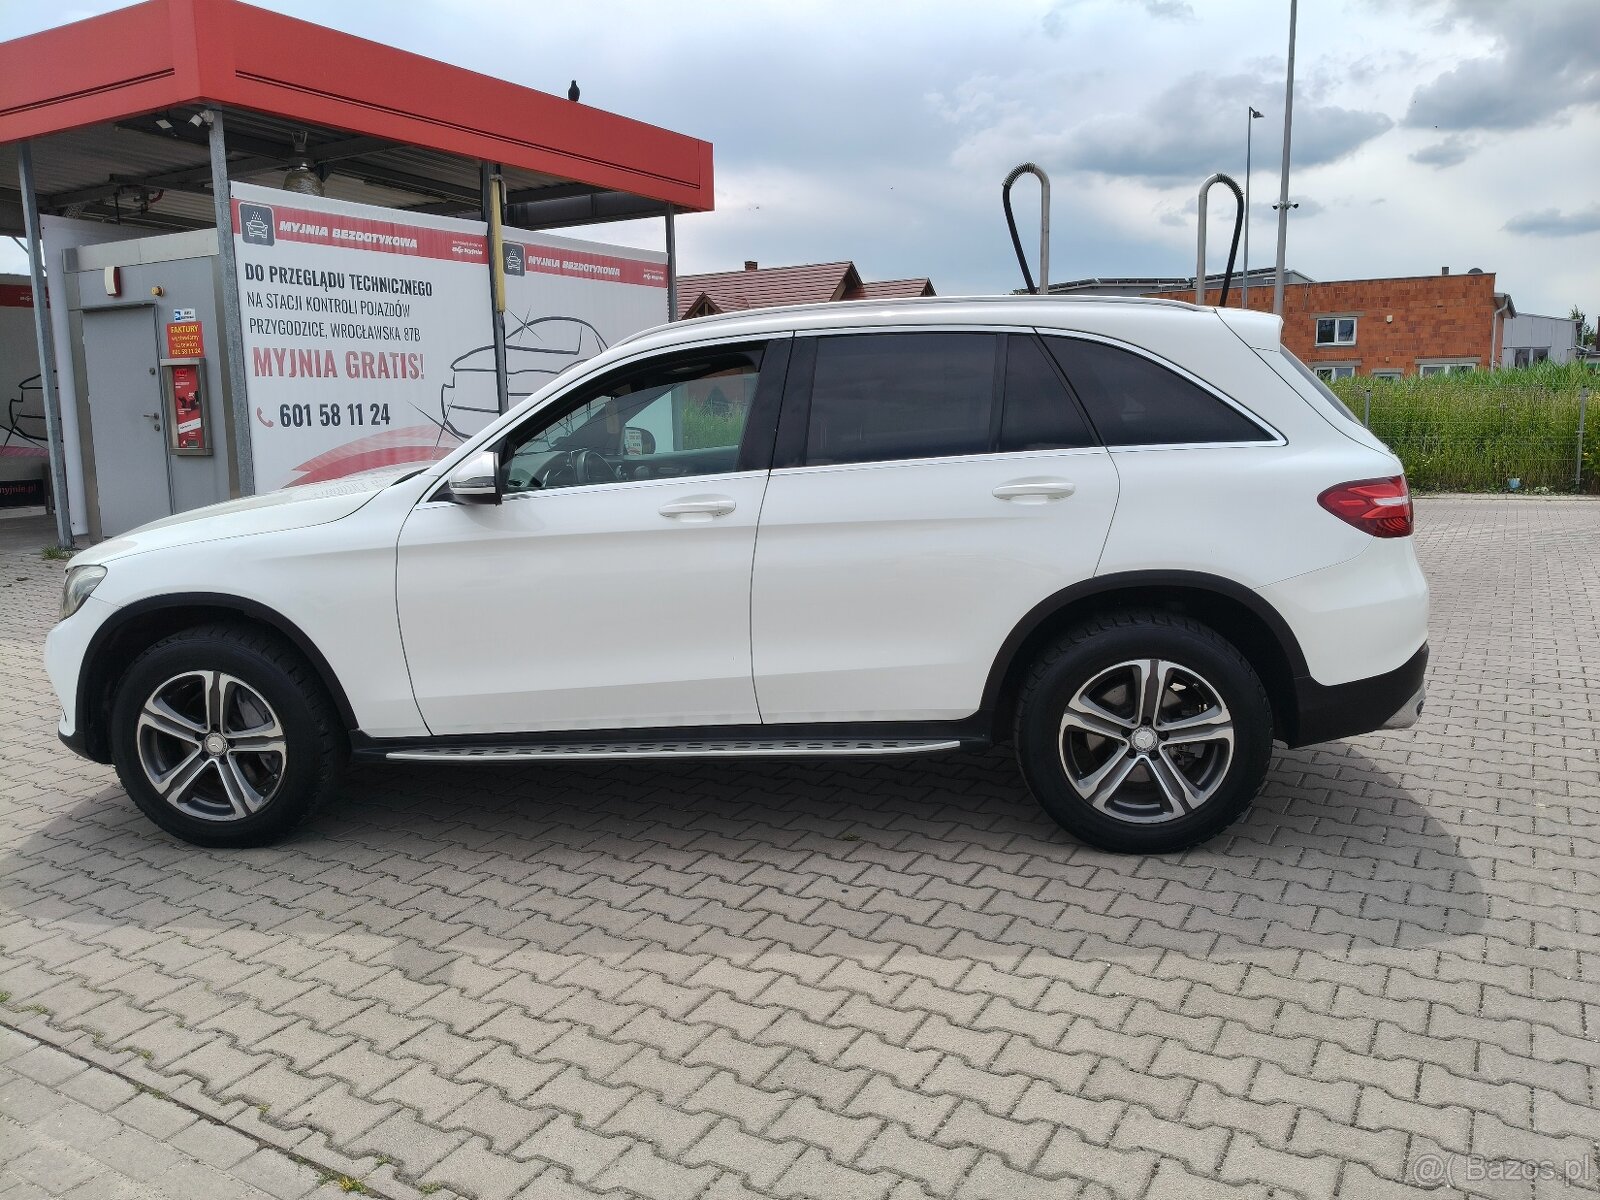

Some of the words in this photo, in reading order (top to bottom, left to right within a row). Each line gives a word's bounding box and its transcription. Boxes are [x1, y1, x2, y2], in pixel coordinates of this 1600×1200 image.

[279, 220, 329, 237] MYJNIA
[332, 229, 418, 249] BEZDOTYKOWA
[528, 255, 561, 268] MYJNIA
[562, 260, 620, 277] BEZDOTYKOWA
[244, 262, 265, 282] DO
[269, 267, 345, 292] PRZEGLĄDU
[349, 273, 433, 297] TECHNICZNEGO
[247, 291, 263, 308] NA
[266, 293, 303, 311] STACJI
[306, 296, 358, 315] KONTROLI
[360, 299, 410, 318] POJAZDÓW
[171, 324, 199, 333] FAKTURY
[249, 318, 328, 339] PRZYGODZICE,
[331, 323, 401, 341] WROCŁAWSKA
[404, 327, 421, 342] 87B
[252, 346, 338, 378] MYJNIA
[345, 351, 425, 380] GRATIS!
[279, 403, 312, 428] 601
[319, 403, 341, 427] 58
[347, 403, 364, 426] 11
[369, 403, 391, 426] 24
